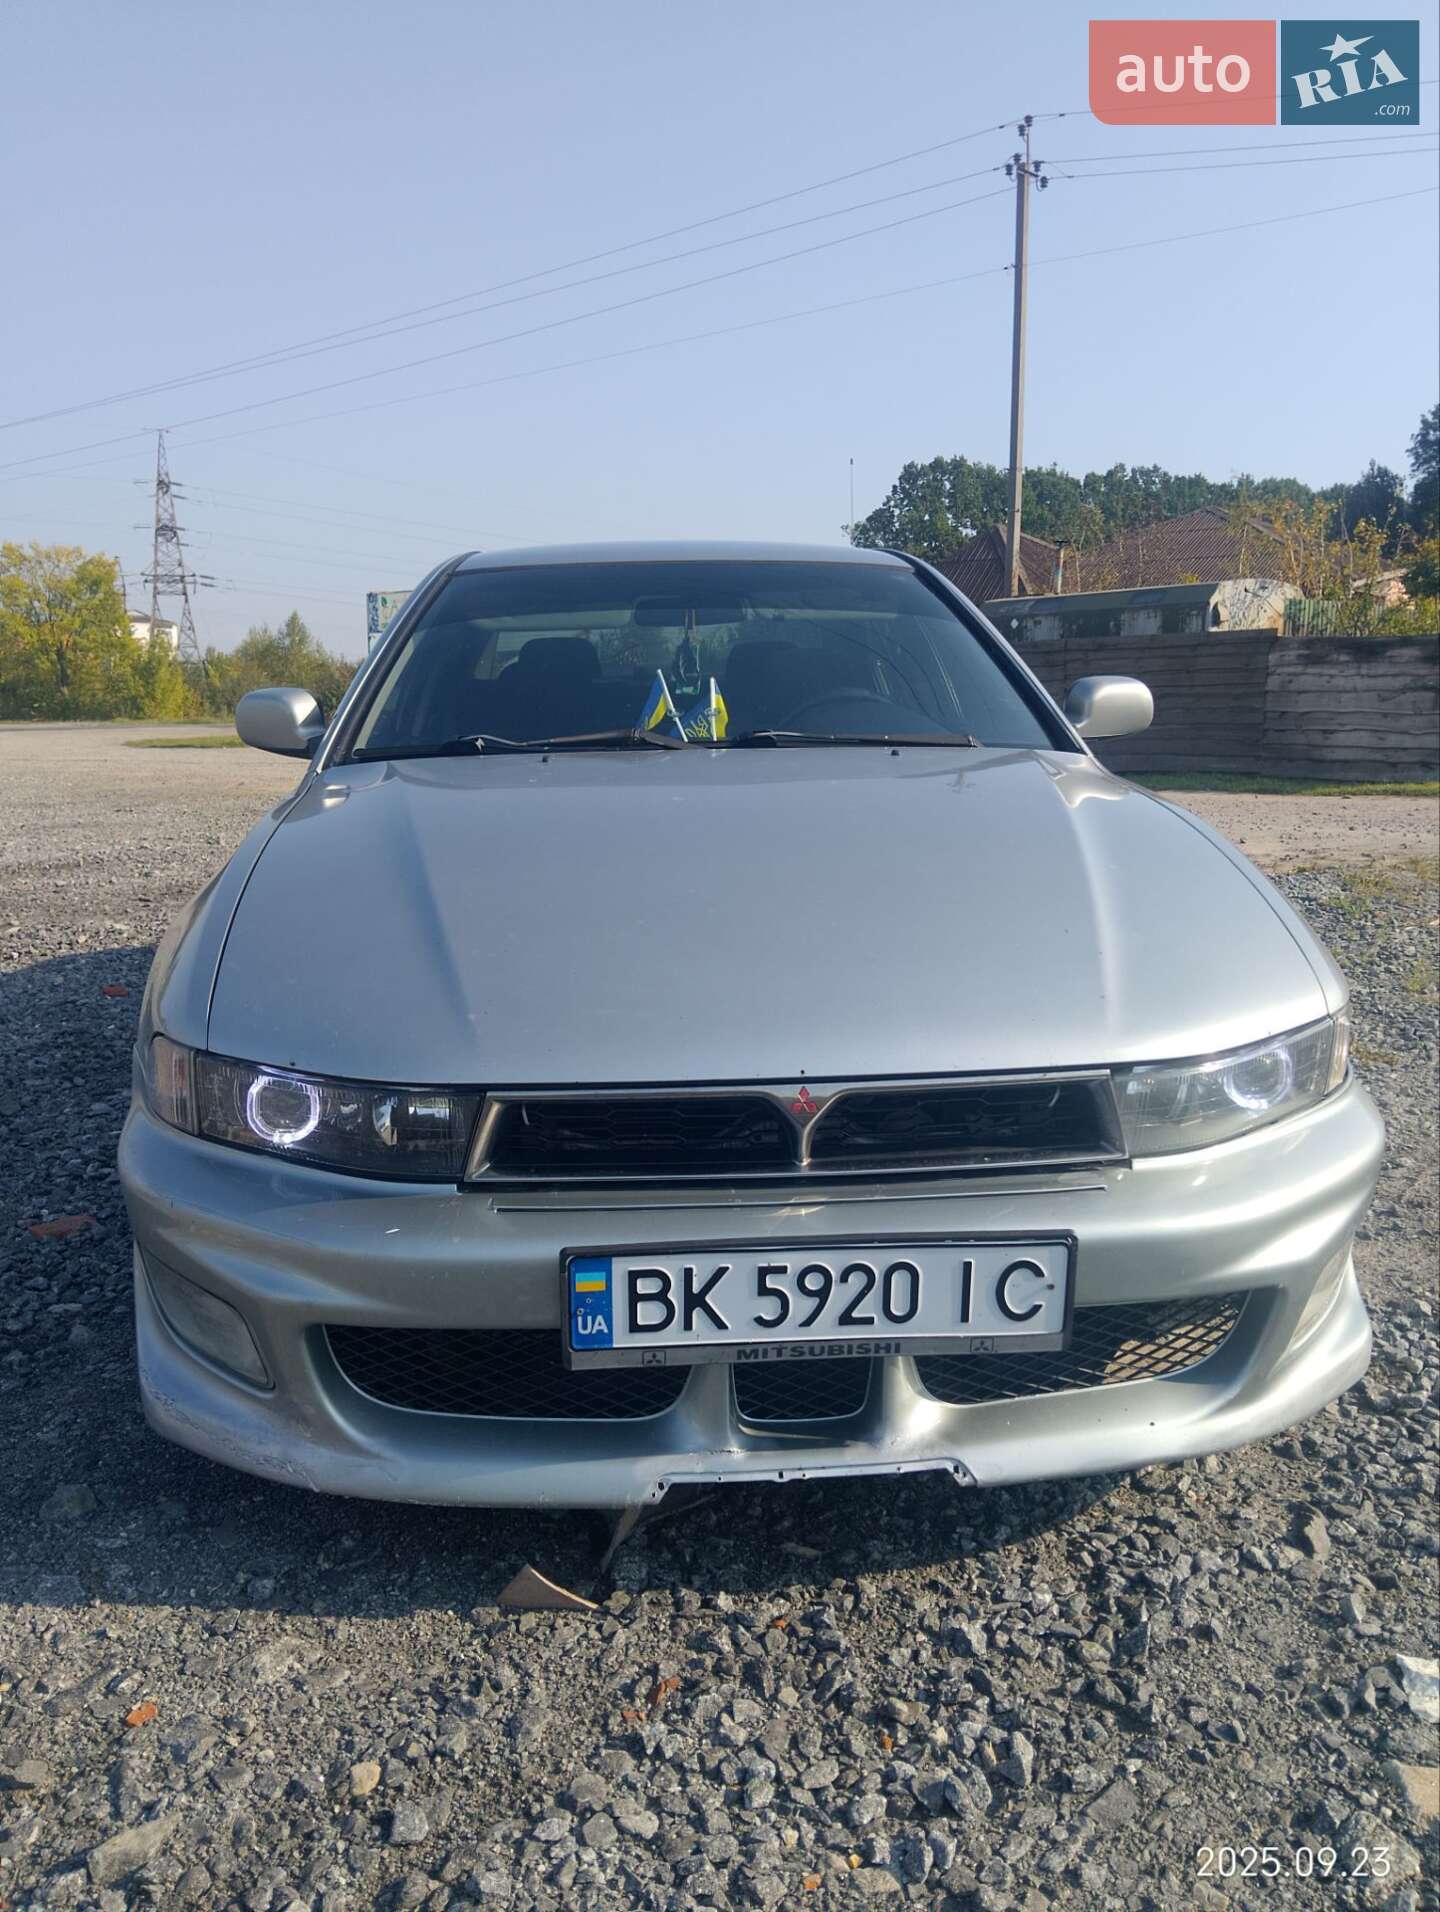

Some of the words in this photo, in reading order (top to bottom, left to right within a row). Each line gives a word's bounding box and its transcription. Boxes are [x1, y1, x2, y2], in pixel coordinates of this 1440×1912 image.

[628, 1265, 731, 1334] BK
[753, 1261, 920, 1329] 5920
[577, 1315, 609, 1334] UA
[735, 1341, 901, 1361] MITSUBISHI
